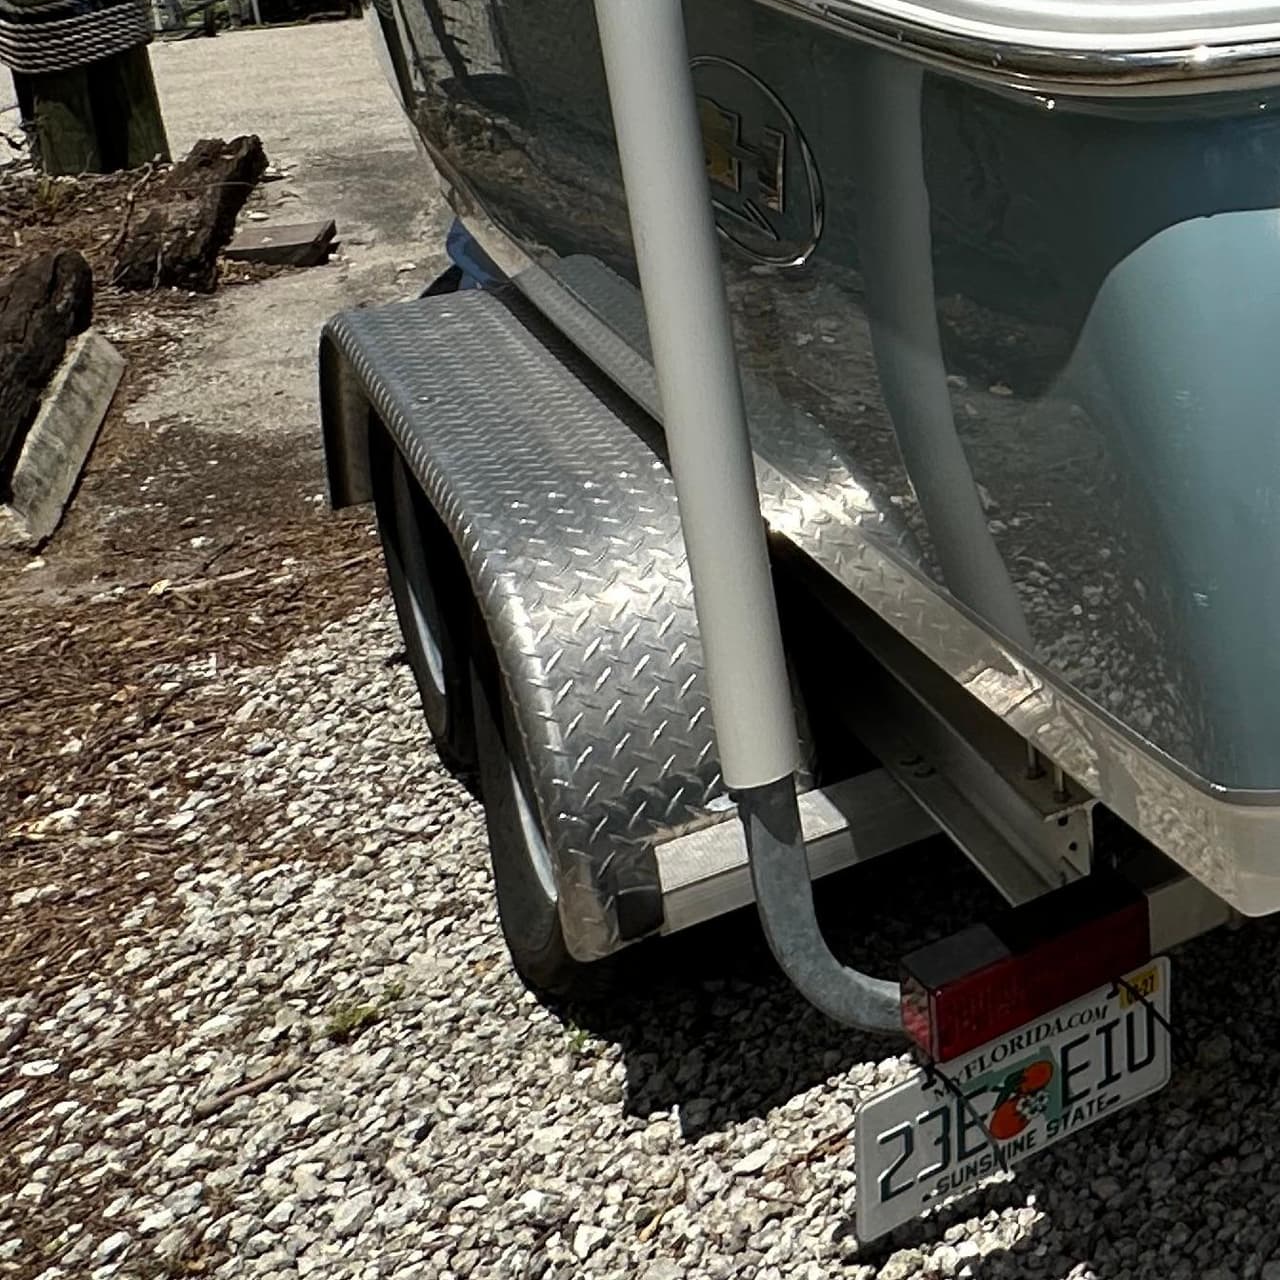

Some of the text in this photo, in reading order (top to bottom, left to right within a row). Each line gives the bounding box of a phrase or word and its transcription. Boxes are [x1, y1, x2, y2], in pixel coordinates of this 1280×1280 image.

[1060, 1004, 1156, 1108] EIU
[936, 1094, 1107, 1195] SUNSHINE STATE
